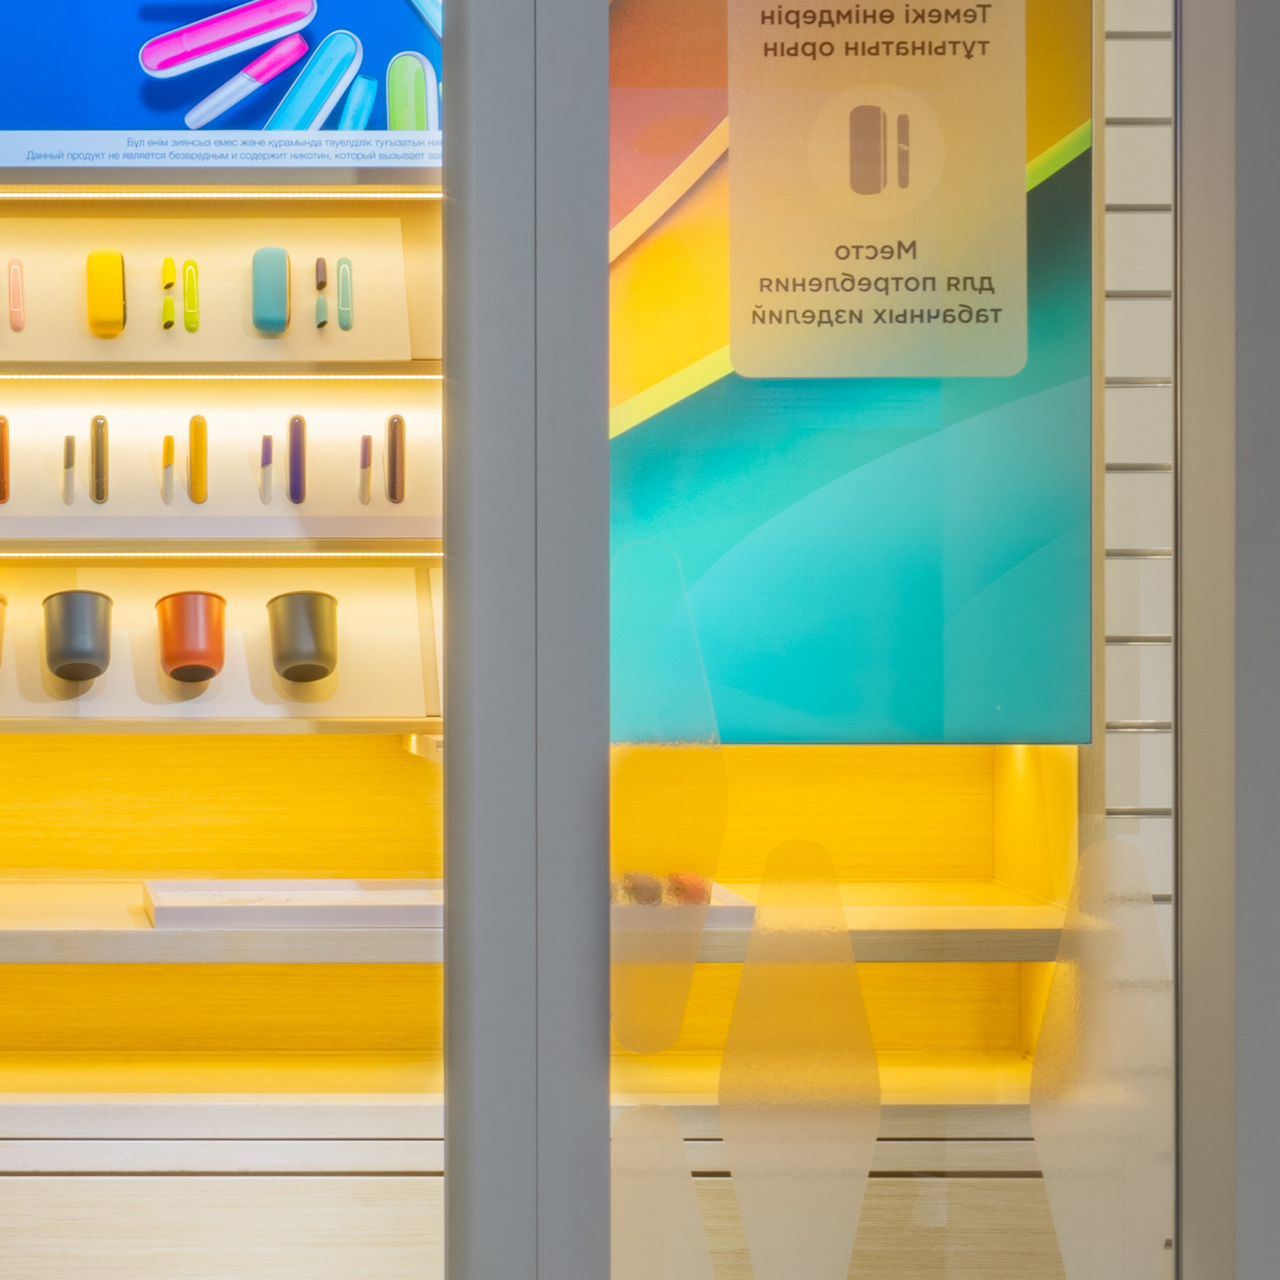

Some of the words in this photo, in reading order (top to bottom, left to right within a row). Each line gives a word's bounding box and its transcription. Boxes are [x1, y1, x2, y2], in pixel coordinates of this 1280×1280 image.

[171, 139, 211, 147] зиянсыз
[213, 139, 238, 147] емес
[26, 150, 64, 161] Данный
[67, 152, 105, 162] продукт
[108, 152, 120, 160] не
[122, 152, 166, 160] является
[169, 150, 229, 161] безвредным
[231, 152, 238, 160] и
[240, 152, 287, 161] содержит
[290, 152, 333, 161] никотин,
[335, 150, 376, 162] который
[379, 152, 426, 160] вызывает
